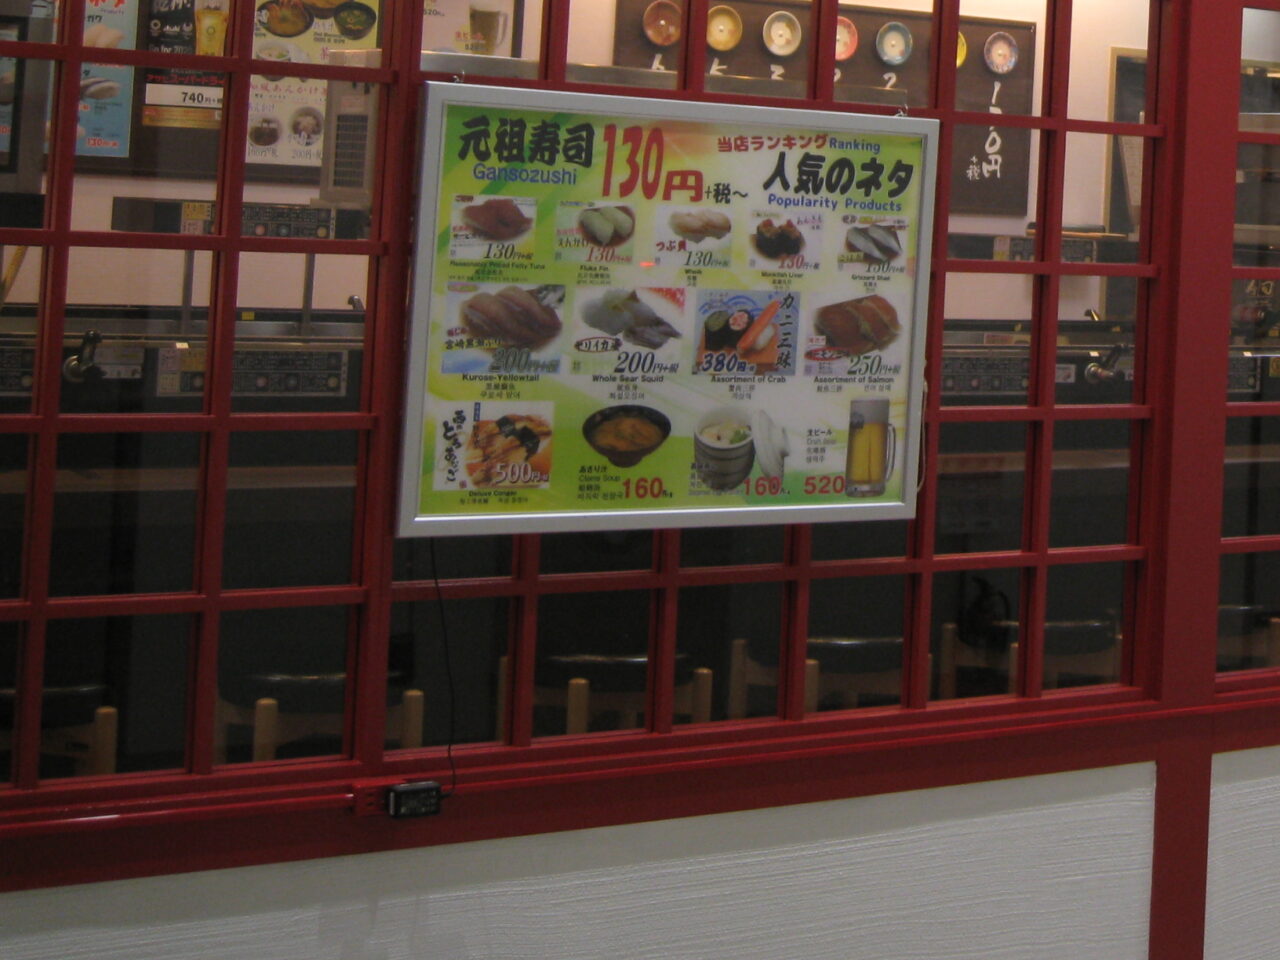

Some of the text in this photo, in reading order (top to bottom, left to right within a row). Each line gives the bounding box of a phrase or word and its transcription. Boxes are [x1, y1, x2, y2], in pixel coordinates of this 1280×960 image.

[457, 114, 595, 168] 元祖寿司
[718, 133, 828, 153] 当店ランキング
[829, 137, 881, 155] Ranking
[473, 162, 577, 186] Gansozushi
[762, 150, 914, 199] 人気のネタ
[768, 193, 902, 212] Popularity Products
[592, 374, 617, 383] Whole
[768, 376, 787, 384] Crab
